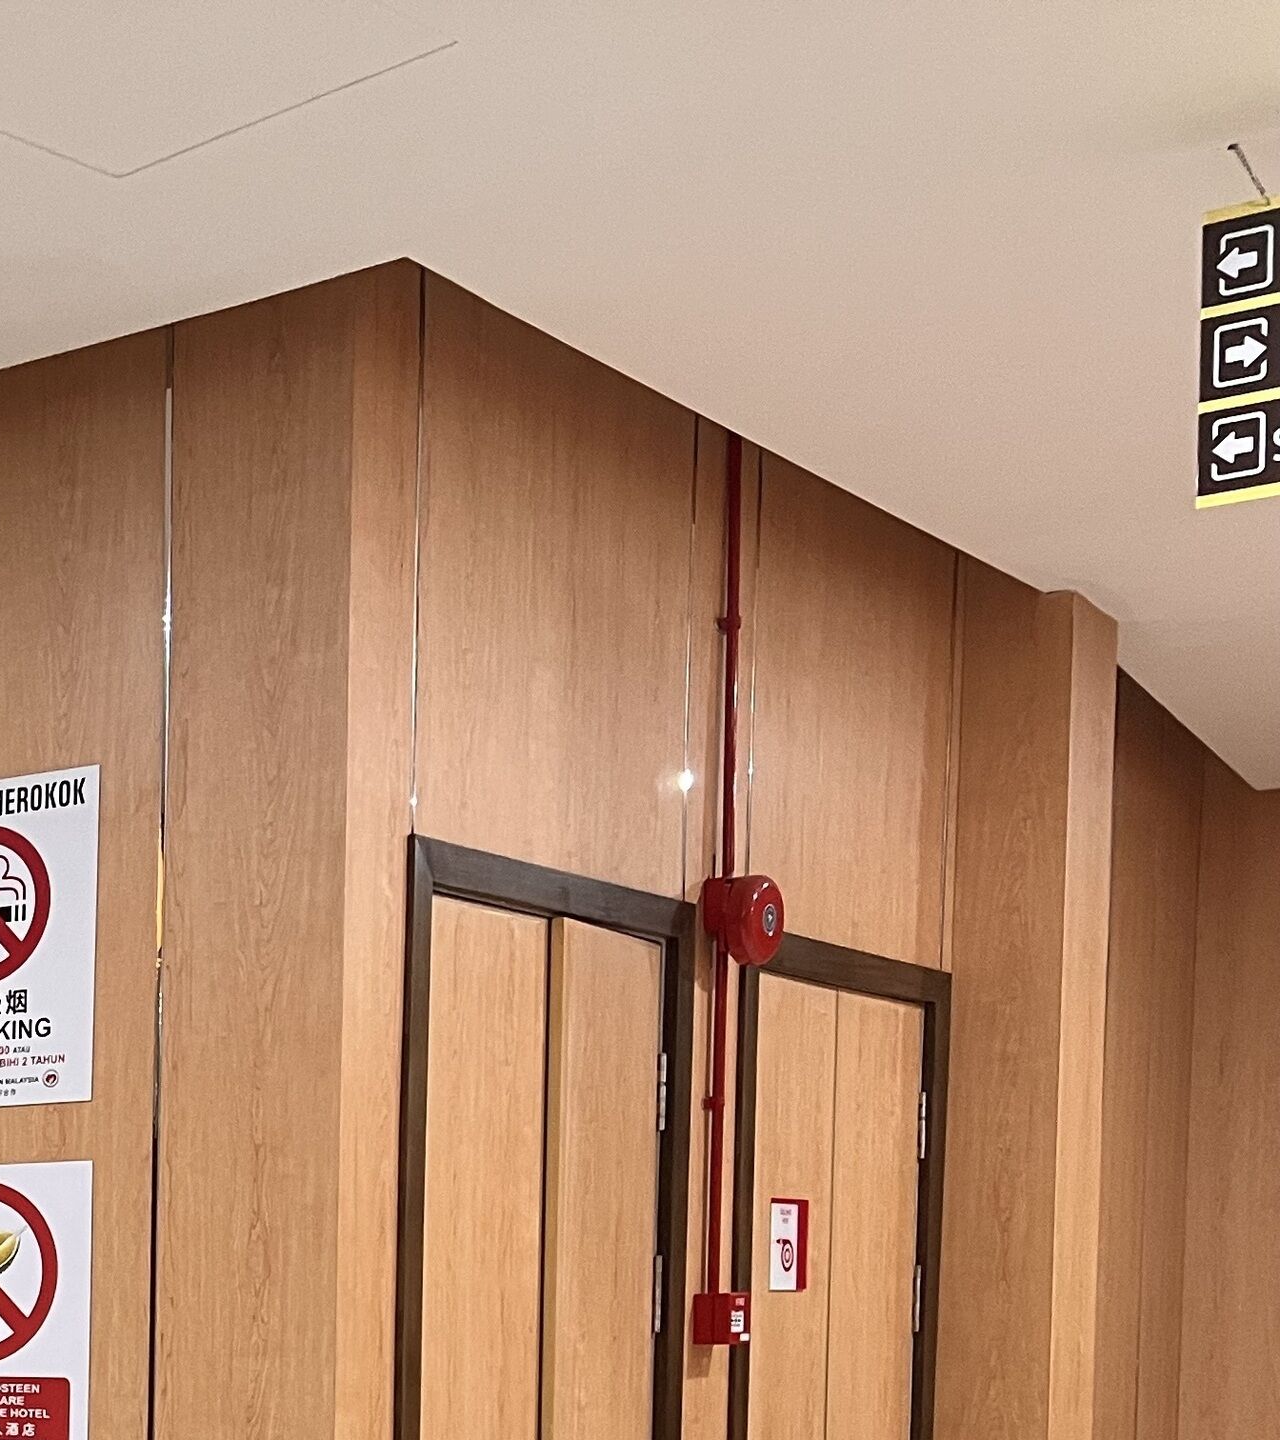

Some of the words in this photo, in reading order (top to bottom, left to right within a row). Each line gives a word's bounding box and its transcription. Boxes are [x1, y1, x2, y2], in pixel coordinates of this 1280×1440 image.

[12, 1046, 31, 1054] ATAU
[22, 1057, 28, 1066] 2
[30, 1054, 66, 1065] TAHUN
[0, 1396, 25, 1406] ARE
[10, 1408, 50, 1419] HOTEL
